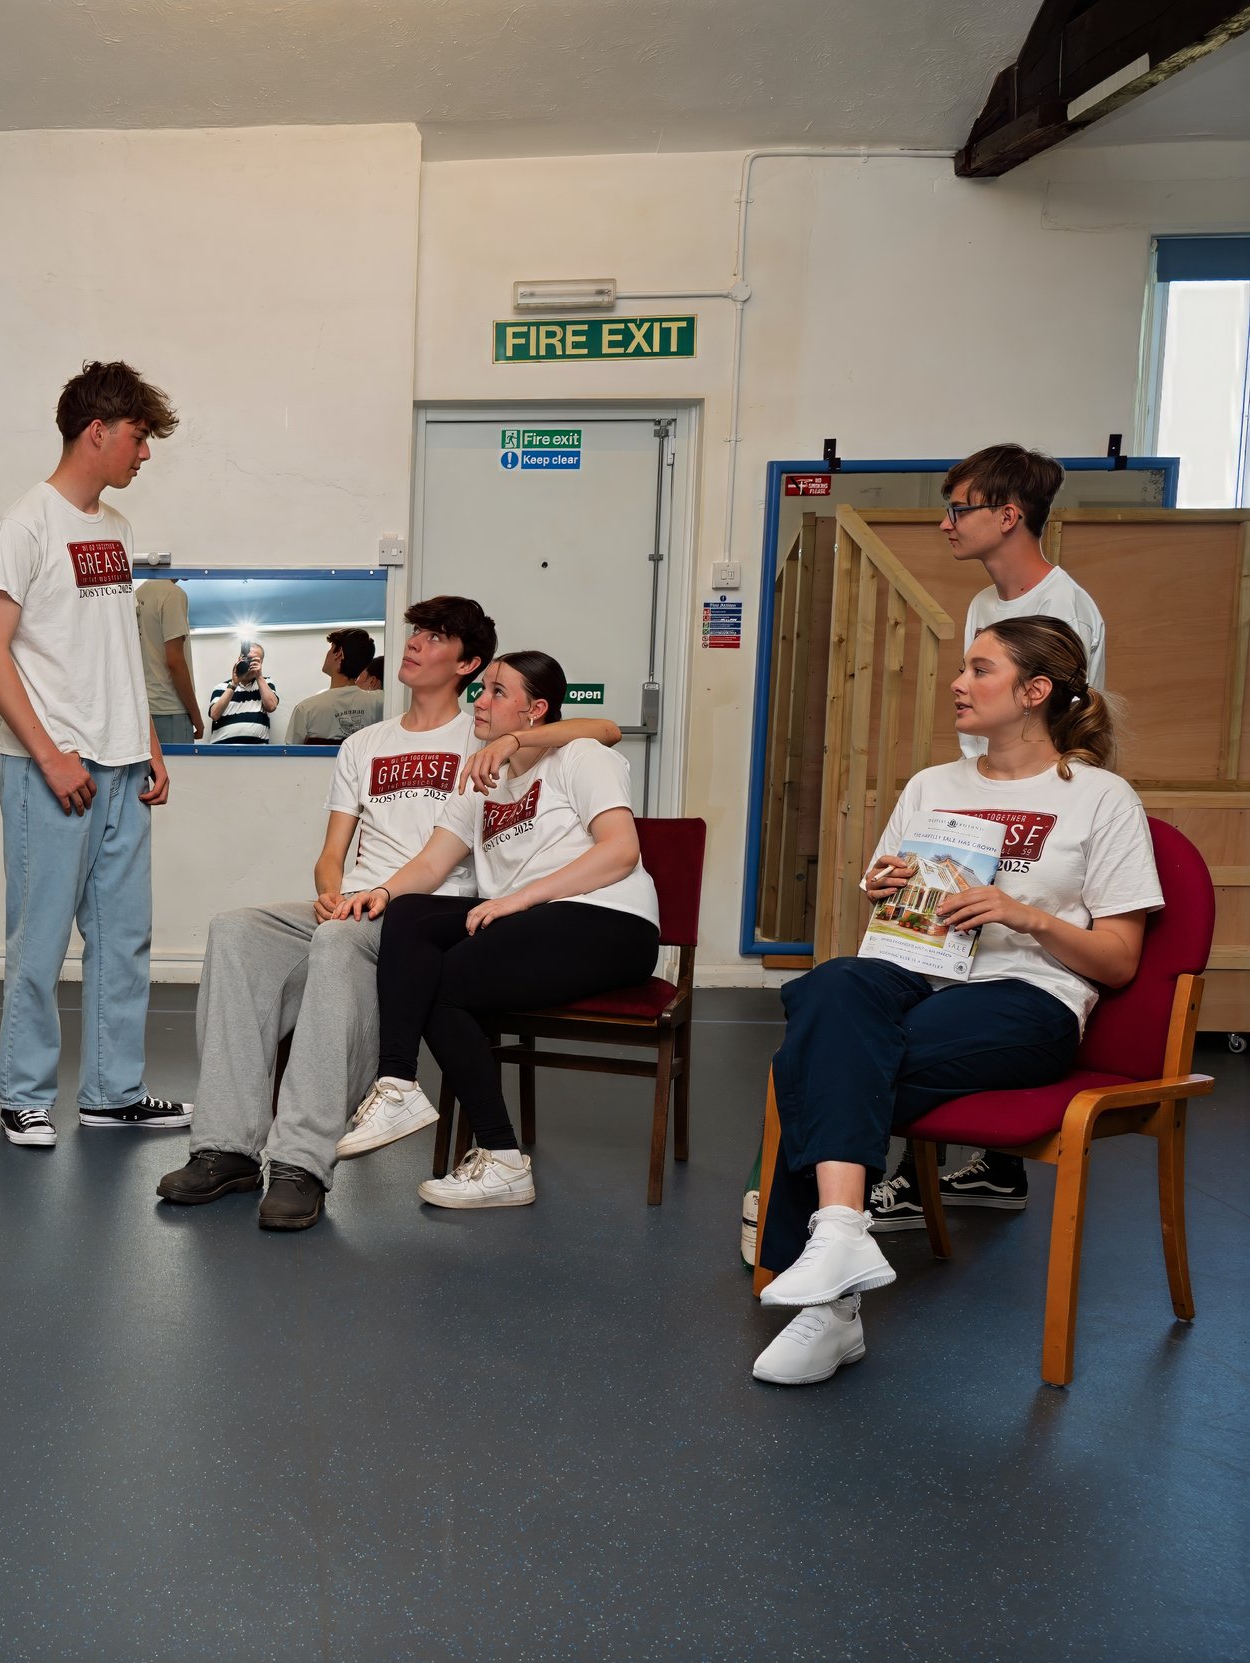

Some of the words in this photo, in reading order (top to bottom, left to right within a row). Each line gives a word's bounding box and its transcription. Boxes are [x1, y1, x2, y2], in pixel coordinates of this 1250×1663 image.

[505, 325, 589, 357] FIRE
[602, 320, 688, 354] EXIT
[523, 432, 551, 446] Fire
[553, 432, 581, 446] exit
[523, 454, 550, 467] Keep
[552, 454, 579, 465] clear
[77, 551, 128, 575] GREASE
[569, 689, 602, 701] open
[377, 760, 453, 785] GREASE
[423, 789, 448, 802] 2025
[513, 820, 534, 837] 2025
[997, 860, 1031, 874] 2025
